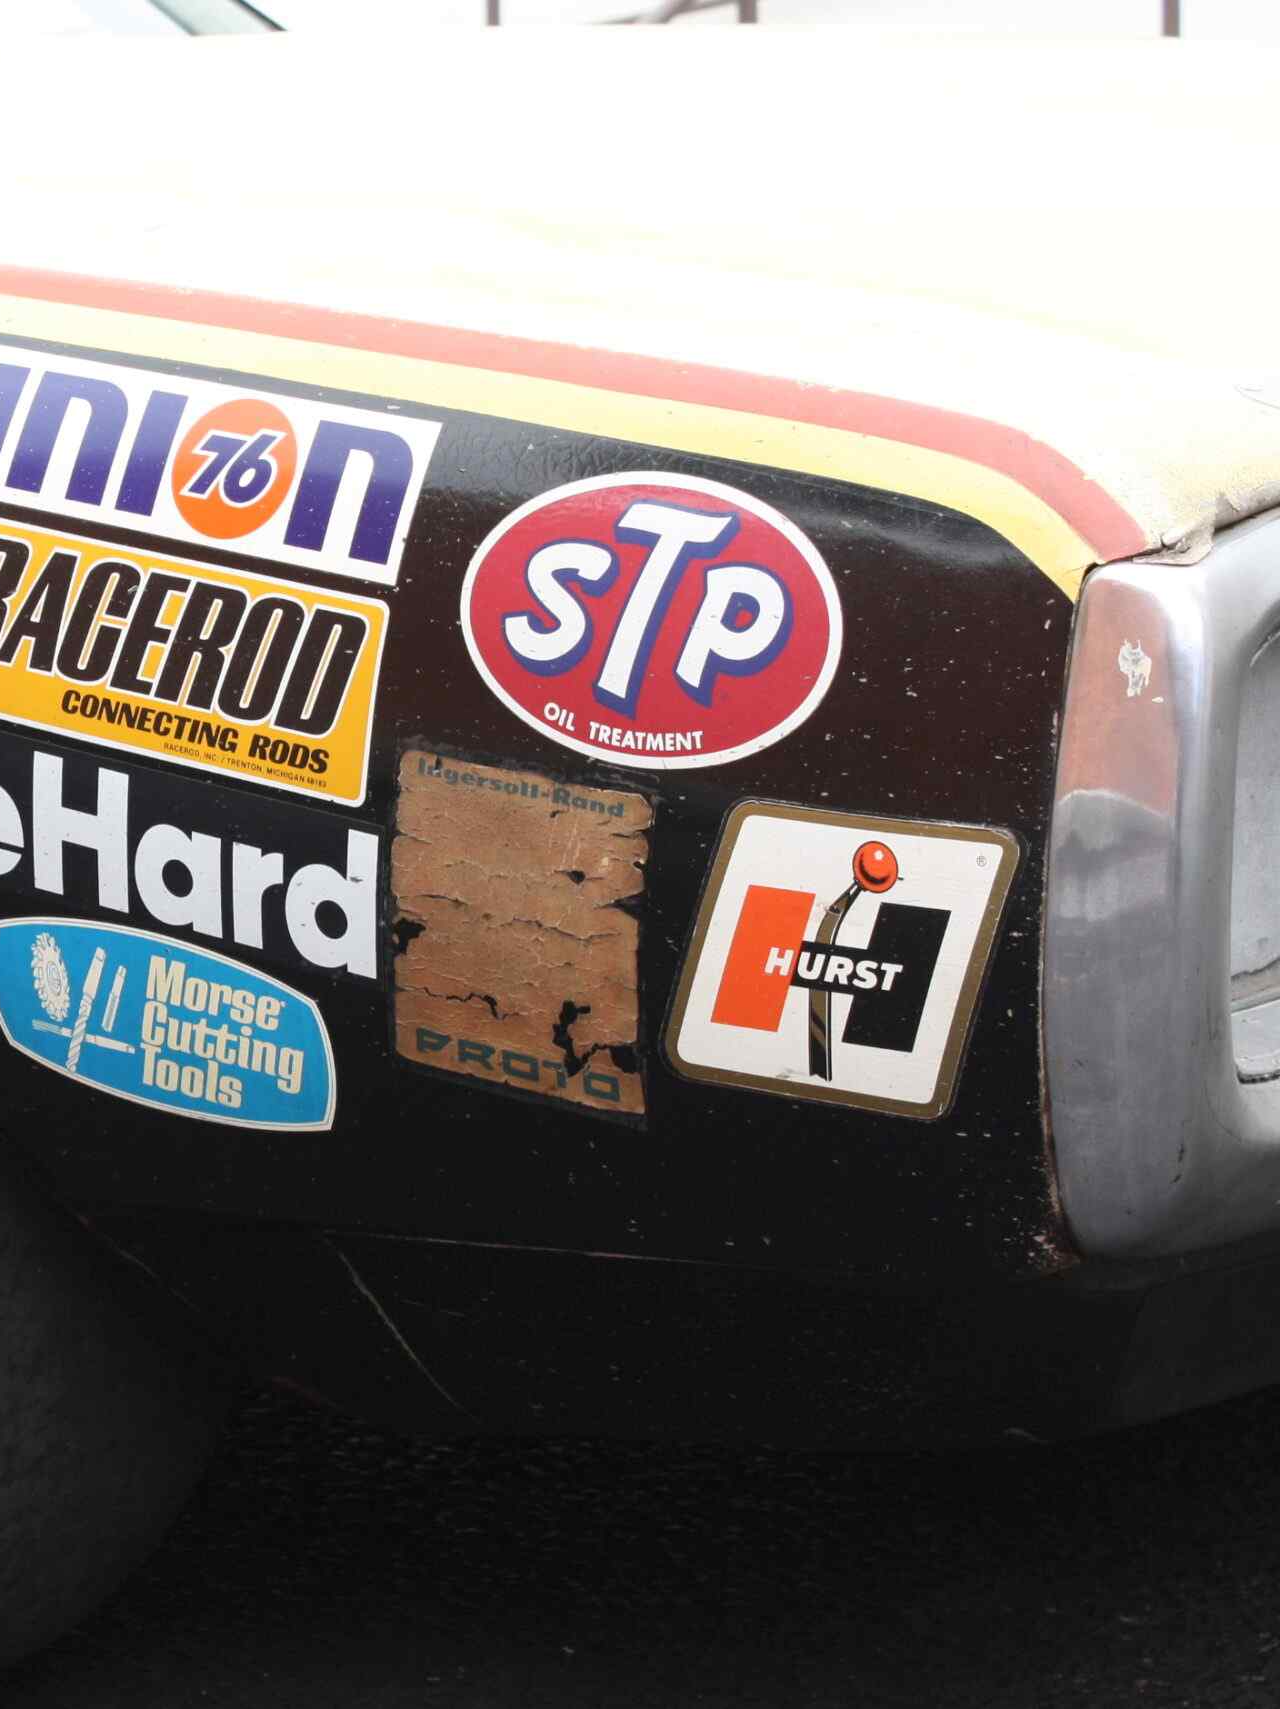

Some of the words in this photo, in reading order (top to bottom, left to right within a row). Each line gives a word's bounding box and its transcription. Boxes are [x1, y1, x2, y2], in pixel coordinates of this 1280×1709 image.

[180, 428, 286, 504] 76
[504, 500, 794, 712] STP
[61, 689, 240, 753] CONNECTING
[248, 733, 330, 774] RODS
[543, 701, 576, 731] OIL
[588, 721, 703, 751] TREATMENT
[146, 955, 282, 1031] Morse
[763, 946, 904, 992] HURST
[140, 1042, 244, 1109] Tools
[141, 1000, 304, 1095] Cutting
[415, 1027, 621, 1103] PROTO
